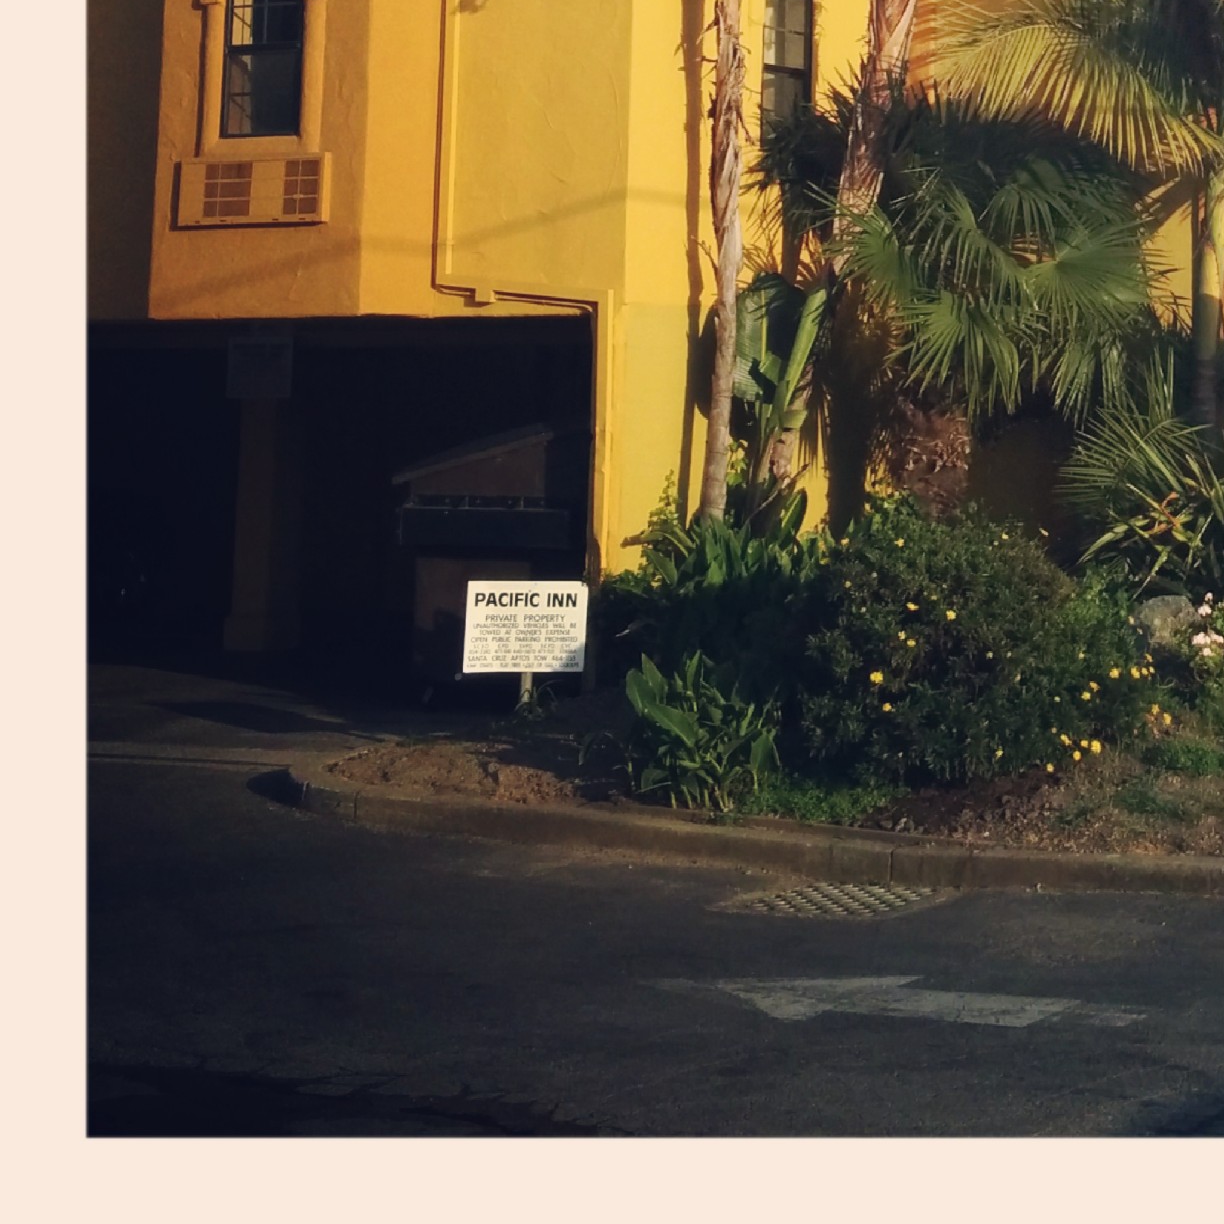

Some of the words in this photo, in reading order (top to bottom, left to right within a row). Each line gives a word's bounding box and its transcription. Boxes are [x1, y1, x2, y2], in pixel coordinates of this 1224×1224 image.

[474, 592, 540, 608] PACIFIC
[546, 593, 578, 608] INN
[485, 614, 518, 623] PRIVATE
[523, 614, 565, 623] PROPERTY
